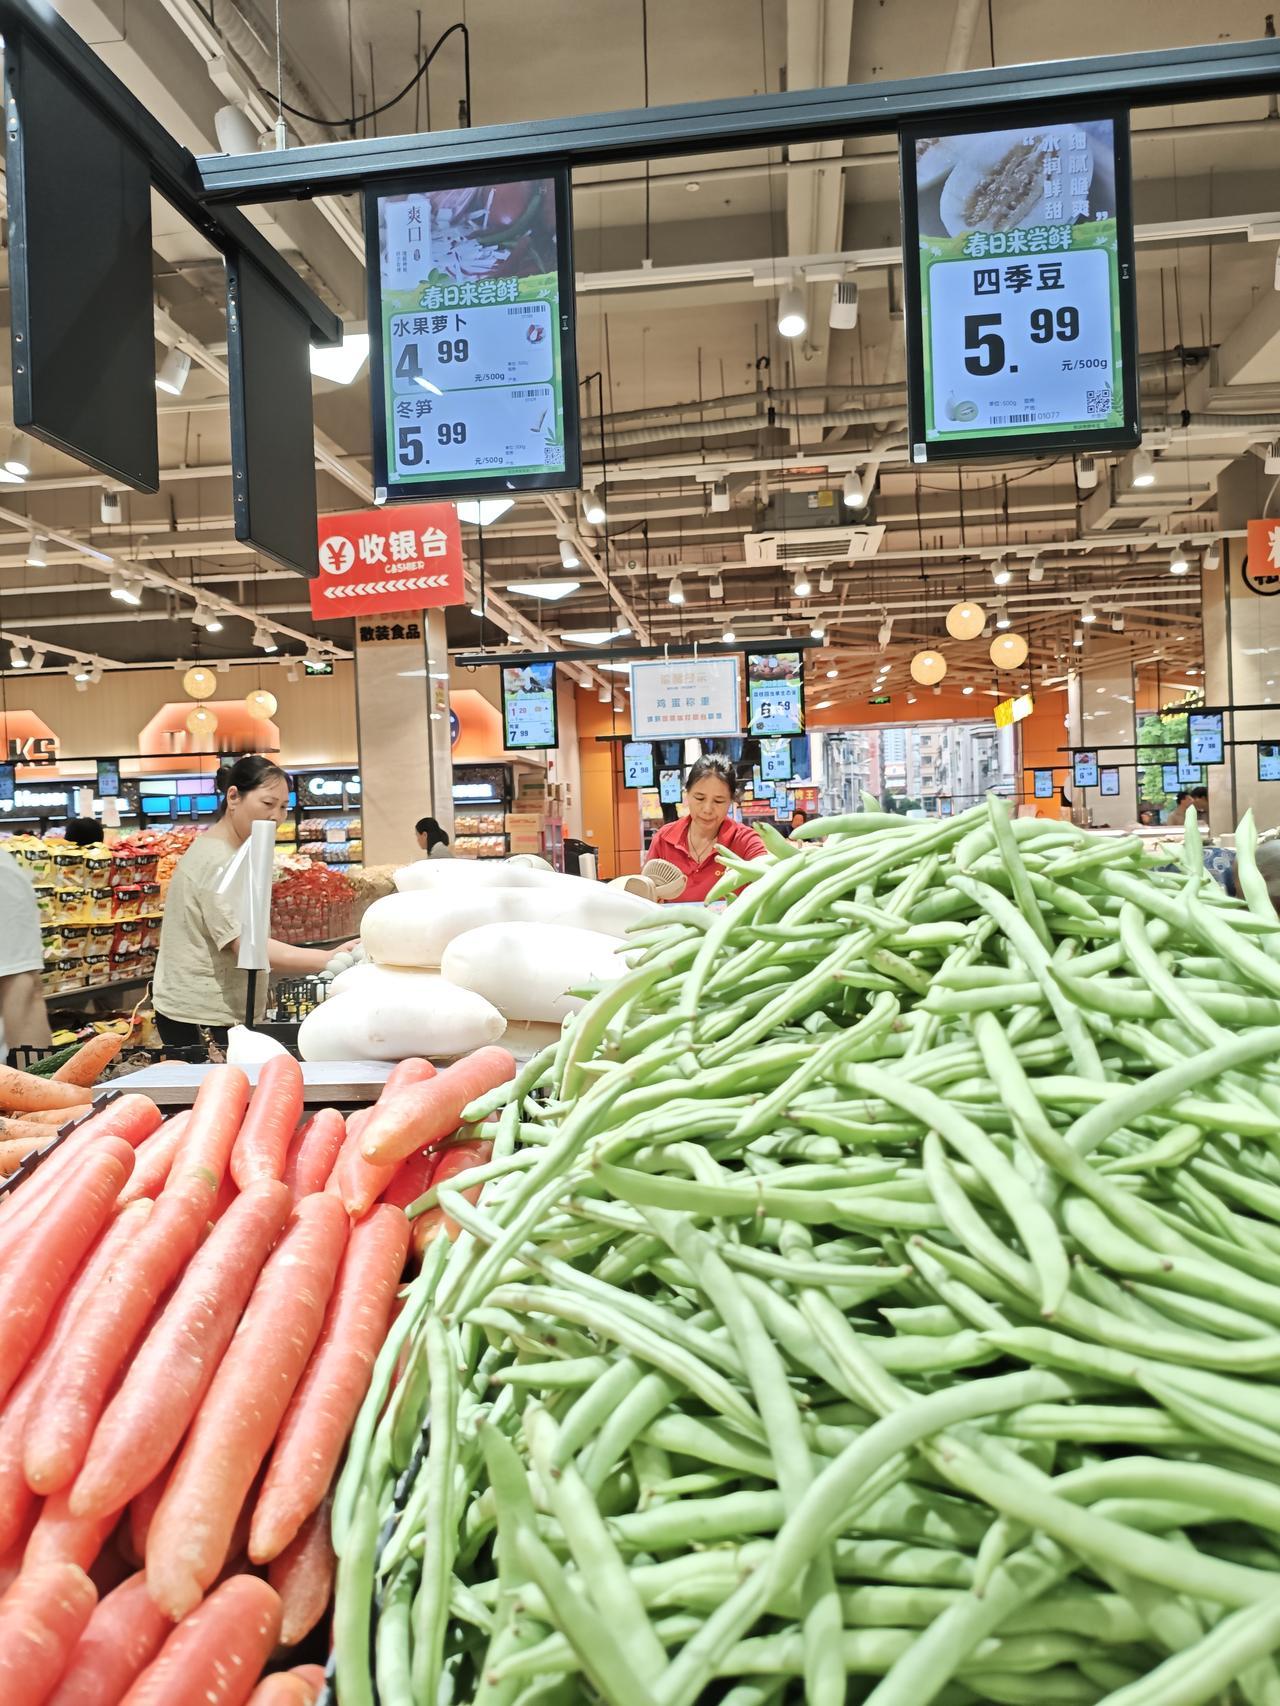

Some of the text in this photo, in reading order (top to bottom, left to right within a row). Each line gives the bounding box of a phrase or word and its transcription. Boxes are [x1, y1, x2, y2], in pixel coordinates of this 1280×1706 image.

[407, 205, 422, 243] 爽口
[963, 224, 1074, 259] 春日来尝鲜
[973, 261, 1066, 295] 四季豆
[420, 277, 519, 309] 春日来尝鲜
[392, 314, 467, 337] 水果萝卜
[1030, 306, 1080, 344] 99
[437, 338, 469, 364] 99
[1061, 359, 1107, 372] 元/500g
[474, 373, 505, 383] 元/500g
[396, 399, 433, 419] 冬笋
[437, 422, 467, 446] 99
[475, 456, 504, 466] 元/500g
[358, 527, 448, 565] 收银台
[384, 561, 426, 574] CASHIER
[360, 623, 420, 642] 散装食品
[629, 767, 637, 779] 2
[767, 761, 774, 771] 6
